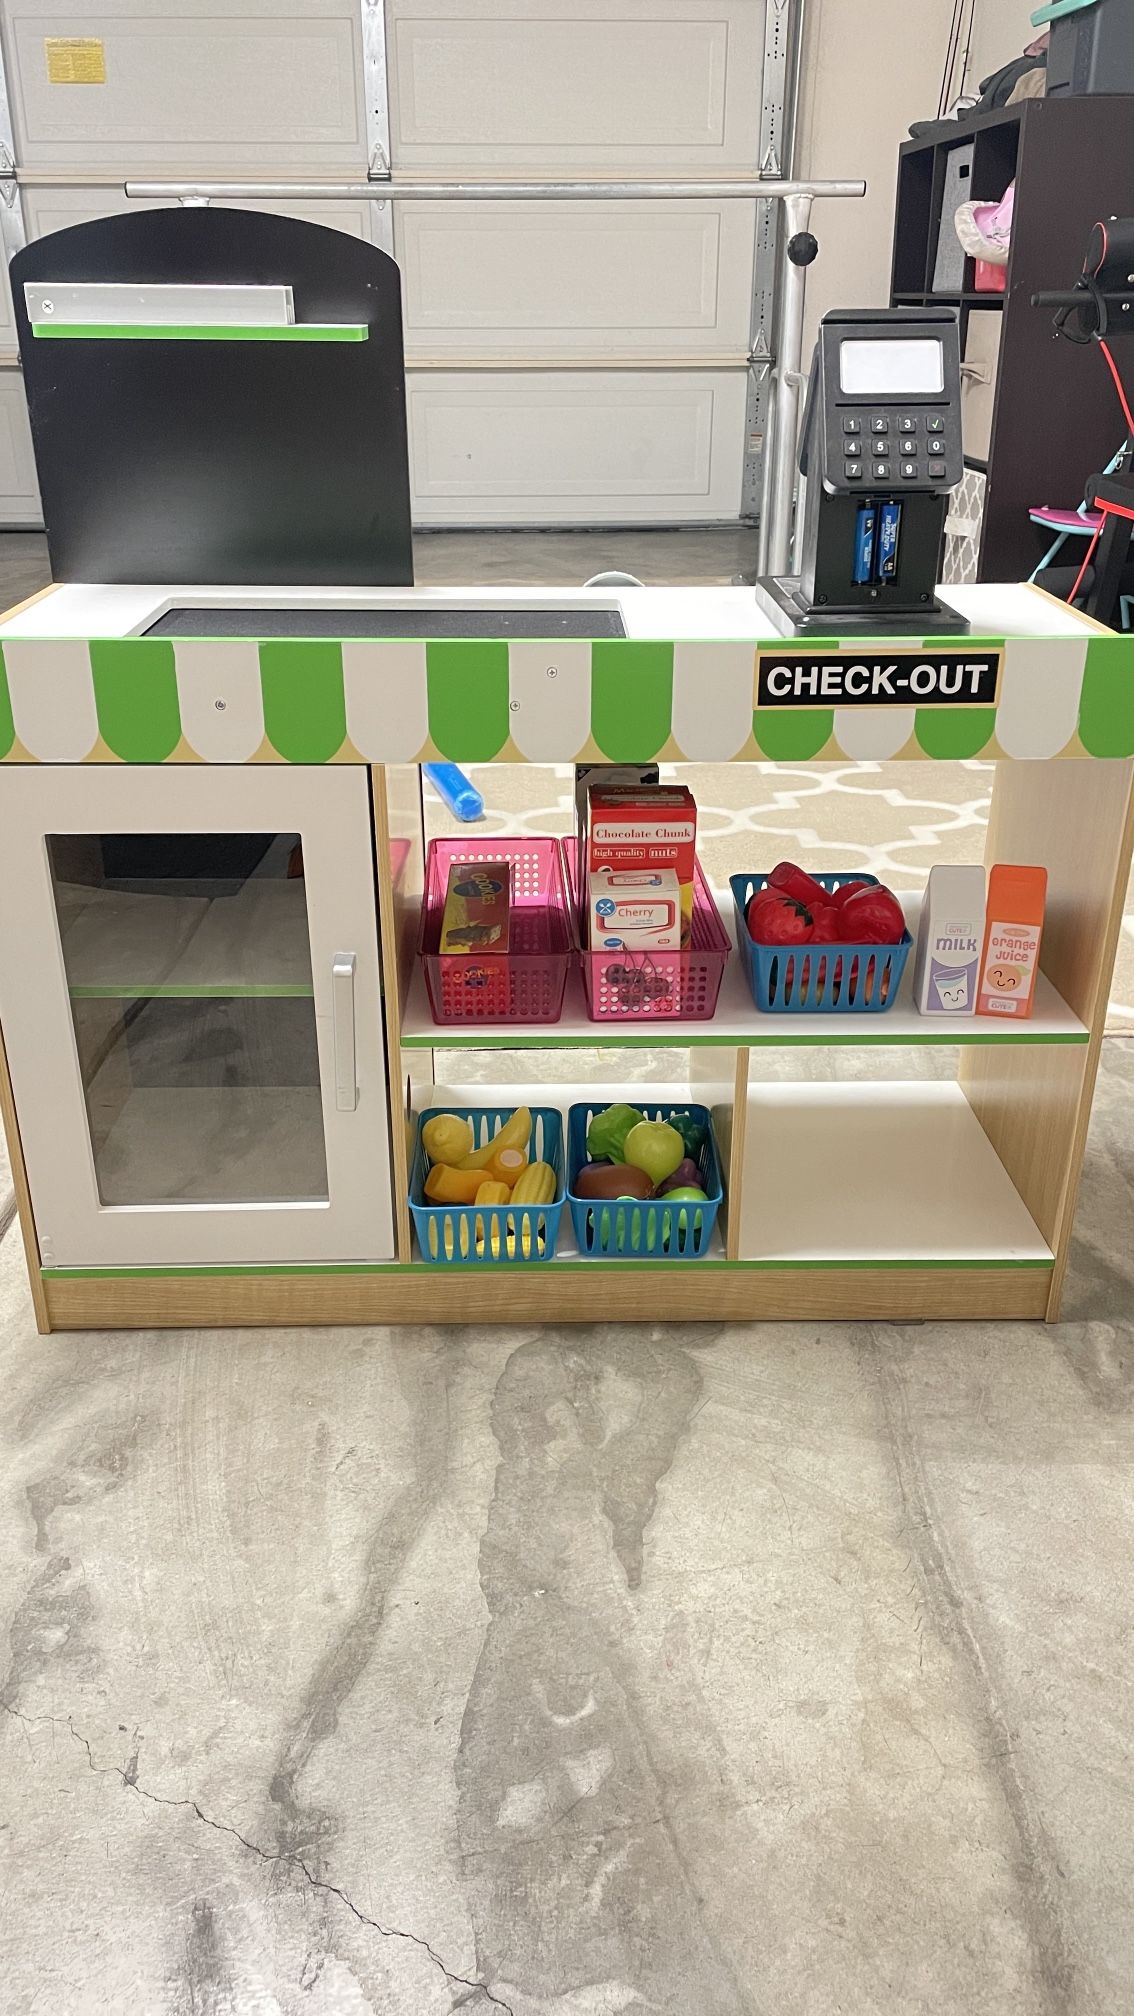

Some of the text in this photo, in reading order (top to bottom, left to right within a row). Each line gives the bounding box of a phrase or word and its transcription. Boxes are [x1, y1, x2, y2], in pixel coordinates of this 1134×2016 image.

[849, 419, 911, 430] 1 2 3
[848, 441, 940, 452] 4 5 6 0
[850, 464, 913, 475] 7 8 9
[766, 664, 989, 696] CHECK-OUT
[596, 827, 691, 839] Chocolate Chunk
[594, 848, 644, 858] high quality
[650, 848, 677, 858] nuts
[471, 872, 496, 906] COOKIES
[618, 908, 654, 918] Cherry
[992, 937, 1036, 950] orange
